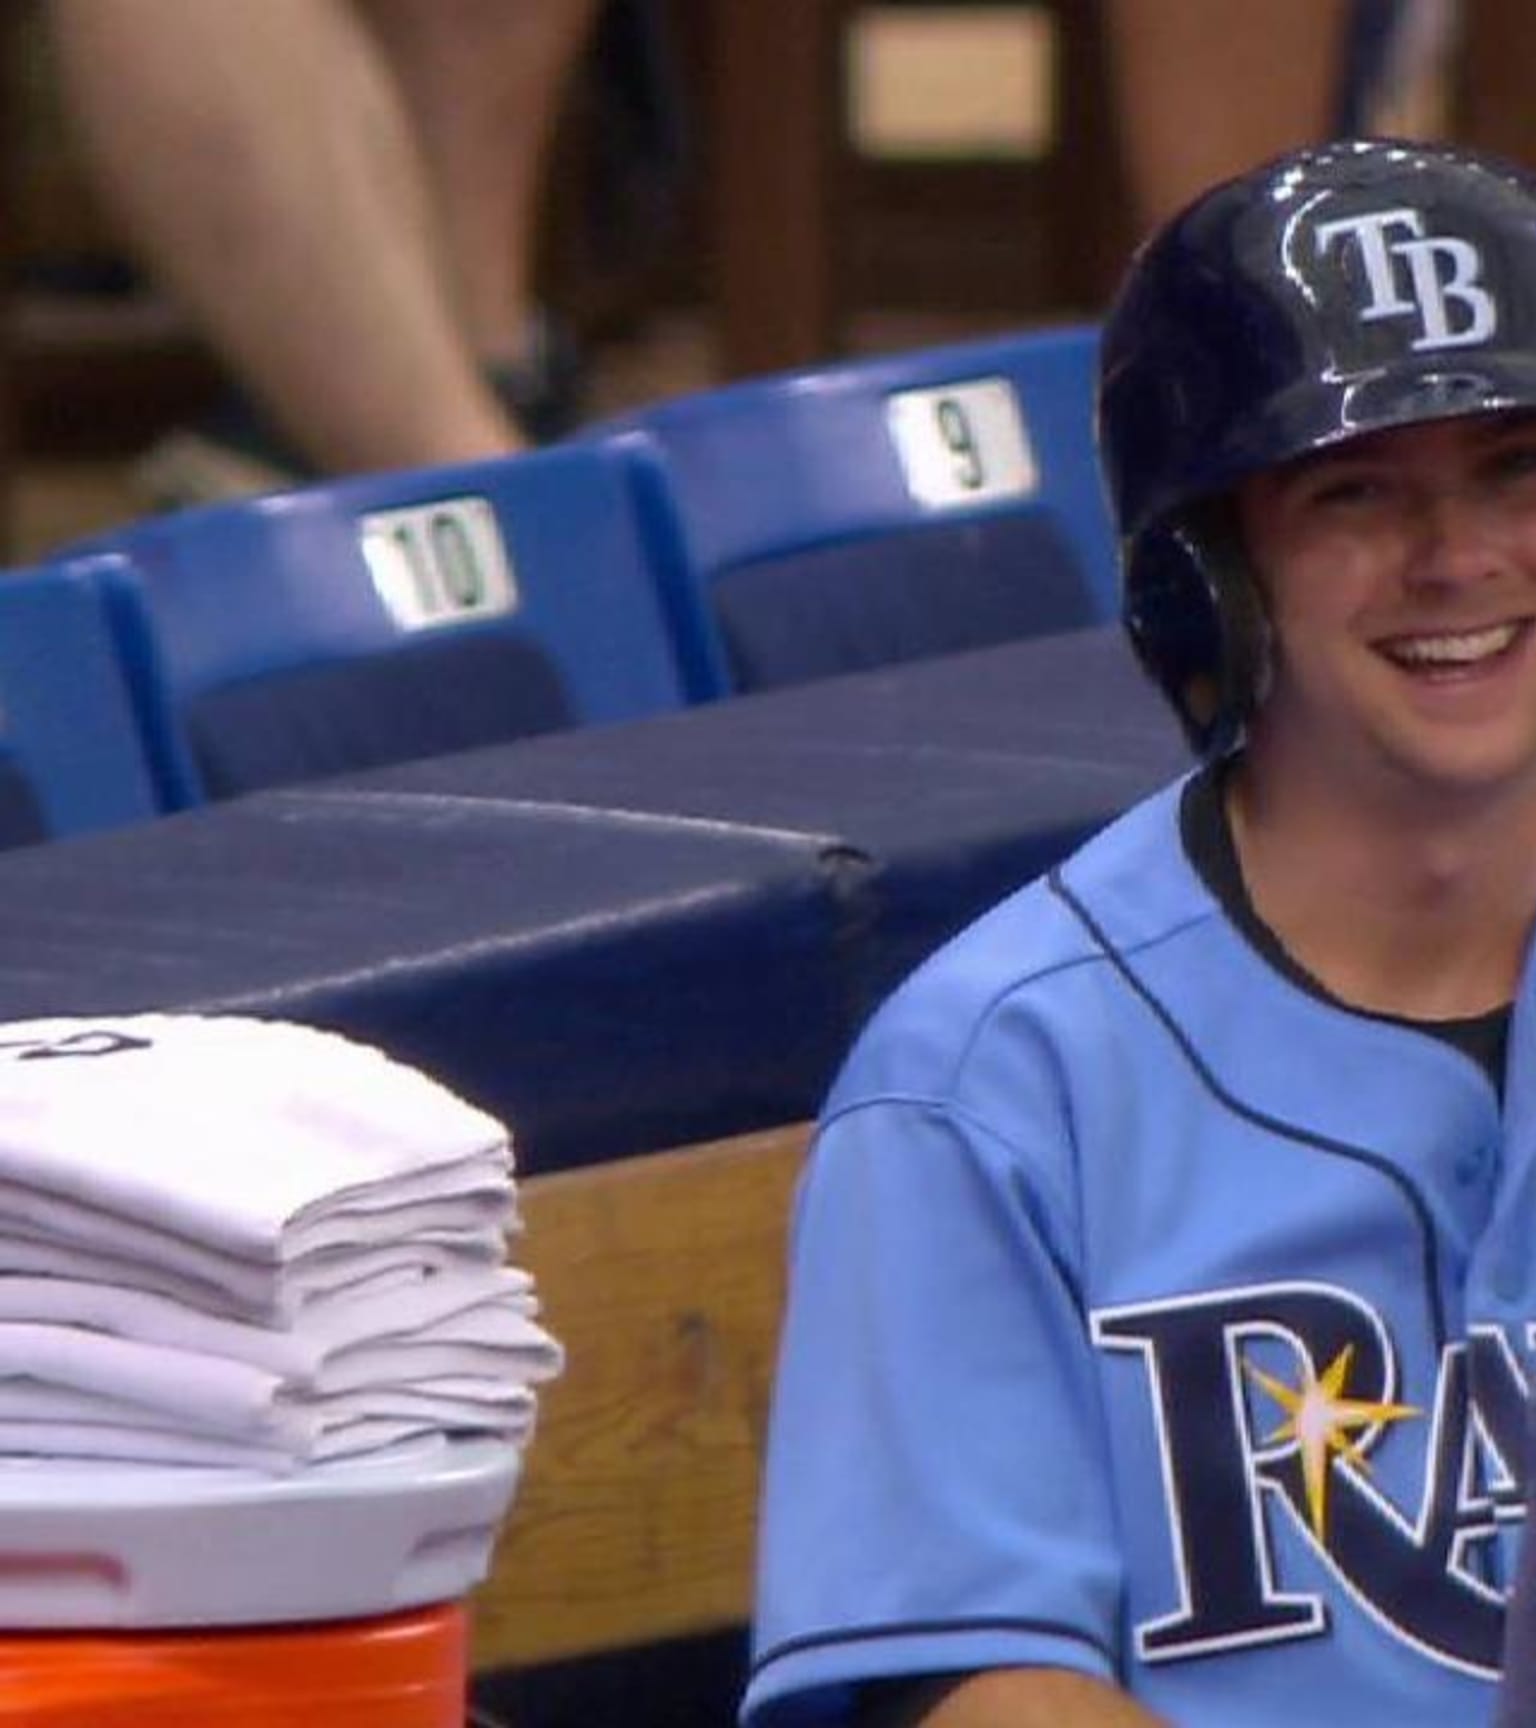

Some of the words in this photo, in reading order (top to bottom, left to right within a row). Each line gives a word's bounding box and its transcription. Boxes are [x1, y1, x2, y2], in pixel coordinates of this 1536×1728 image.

[1314, 208, 1497, 351] TB
[935, 400, 983, 490] 9
[391, 512, 484, 614] 10
